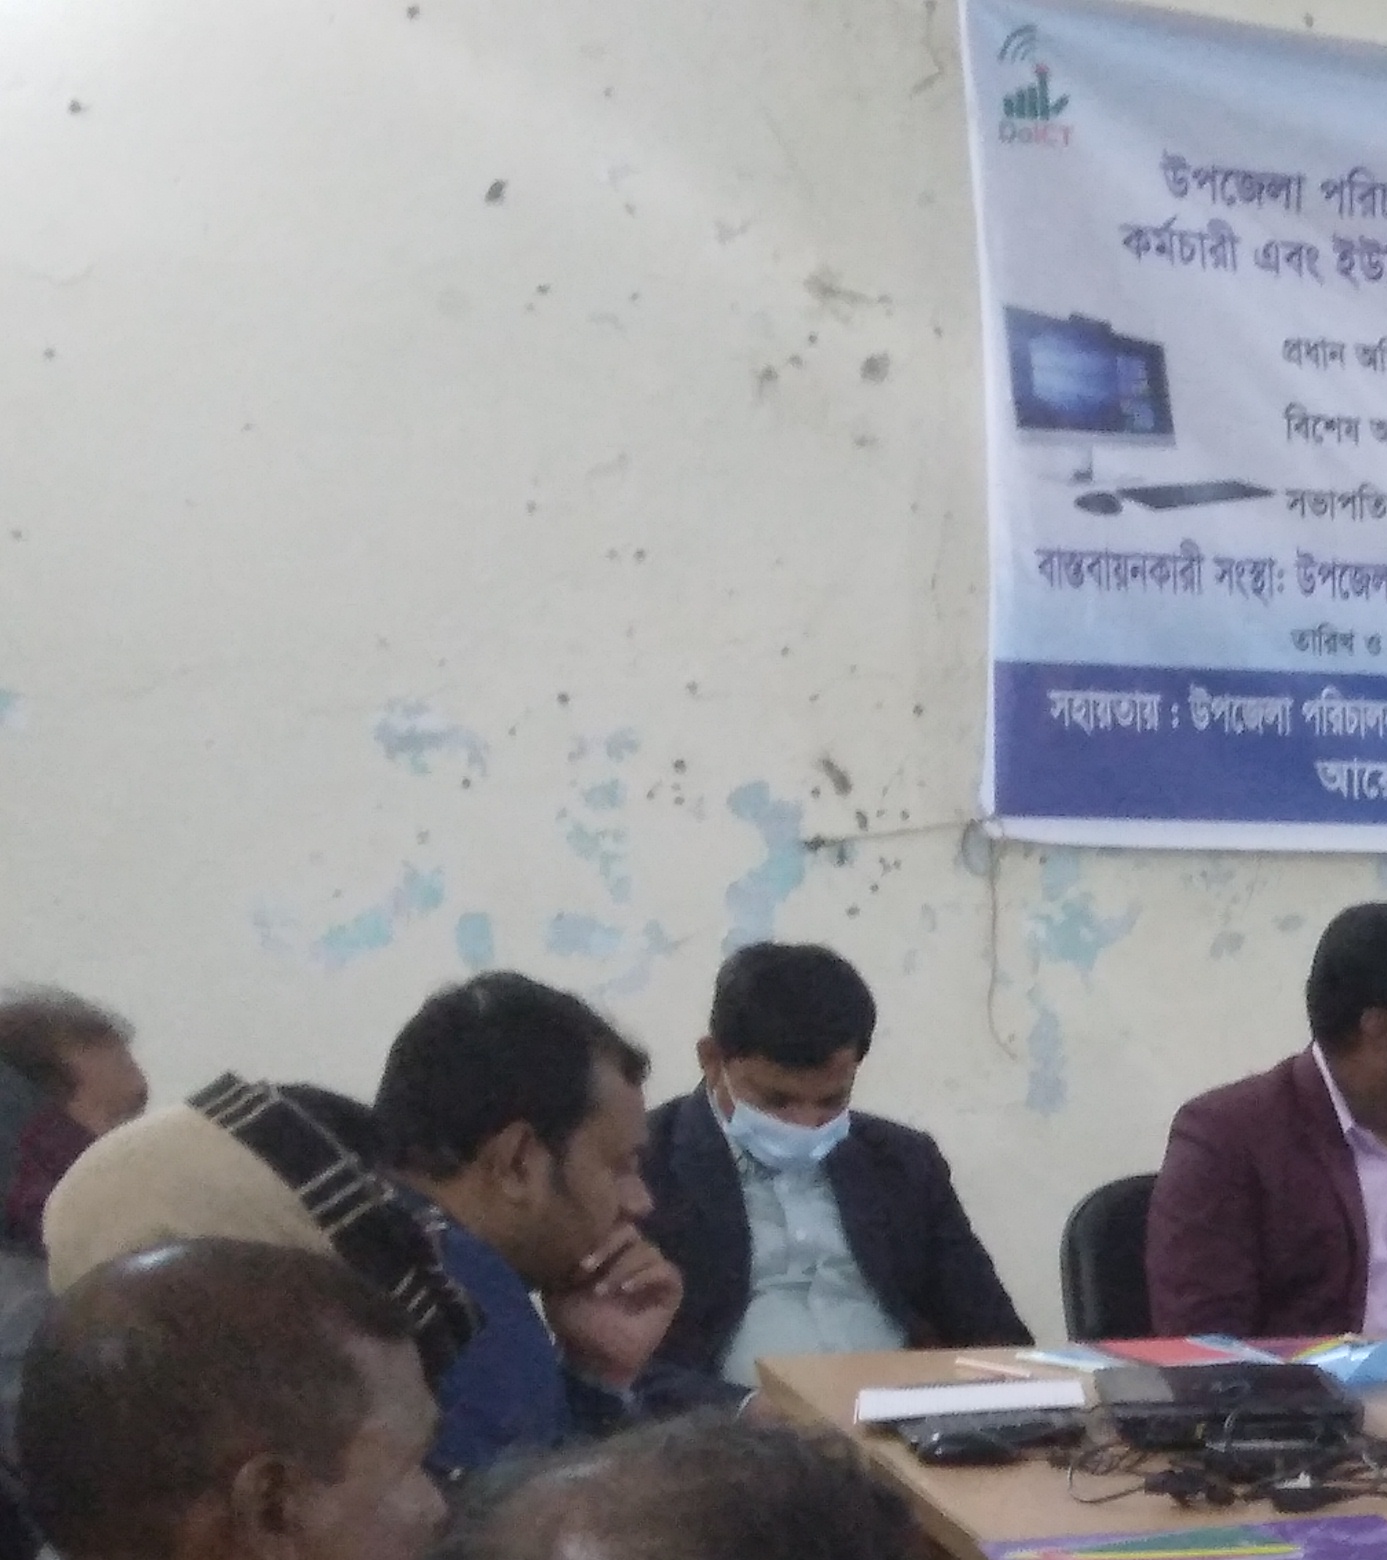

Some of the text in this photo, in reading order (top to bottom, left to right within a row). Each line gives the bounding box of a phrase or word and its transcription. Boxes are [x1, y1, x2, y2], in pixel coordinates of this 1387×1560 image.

[1161, 149, 1304, 214] উপজেলা
[1119, 215, 1240, 273] কর্মচারী
[1254, 239, 1324, 286] এবং
[1282, 338, 1345, 370] প্রধান
[1284, 401, 1360, 447] বিশেষ
[1035, 538, 1204, 595] বাস্তবায়নকারী
[1291, 622, 1354, 656] তারিখ
[1188, 682, 1294, 736] উপজেলা
